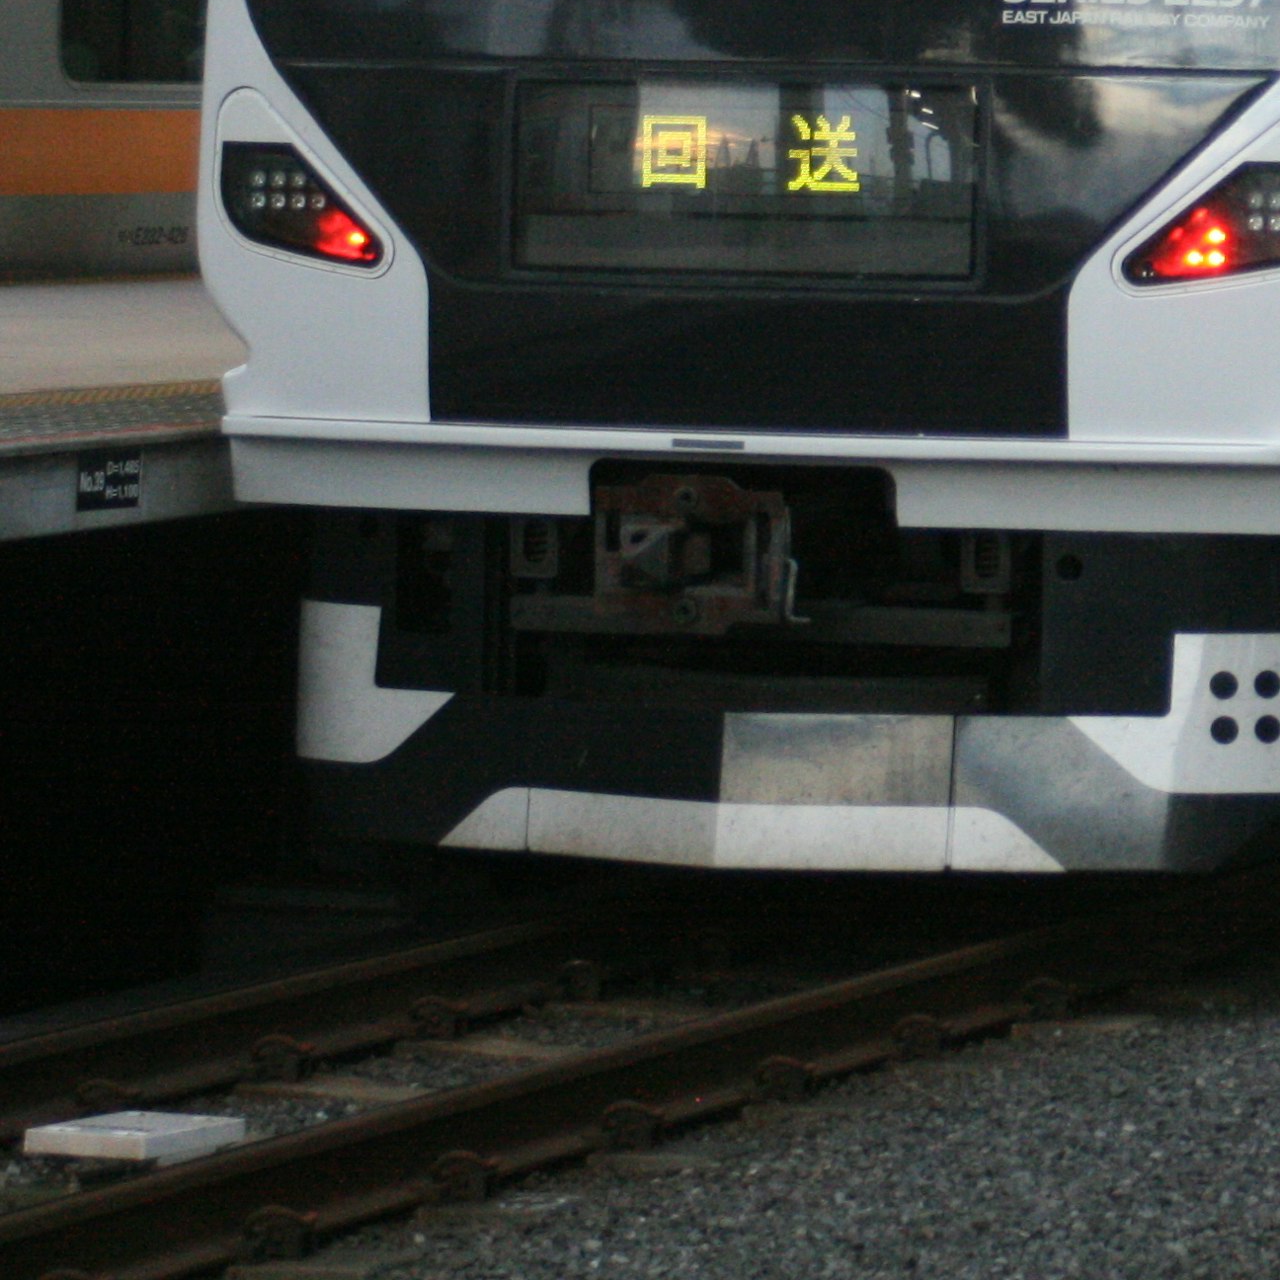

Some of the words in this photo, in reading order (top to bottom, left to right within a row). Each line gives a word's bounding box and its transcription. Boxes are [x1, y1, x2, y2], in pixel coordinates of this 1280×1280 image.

[1002, 10, 1048, 24] EAST
[1184, 14, 1271, 29] COMPANY
[642, 115, 860, 192] 回送
